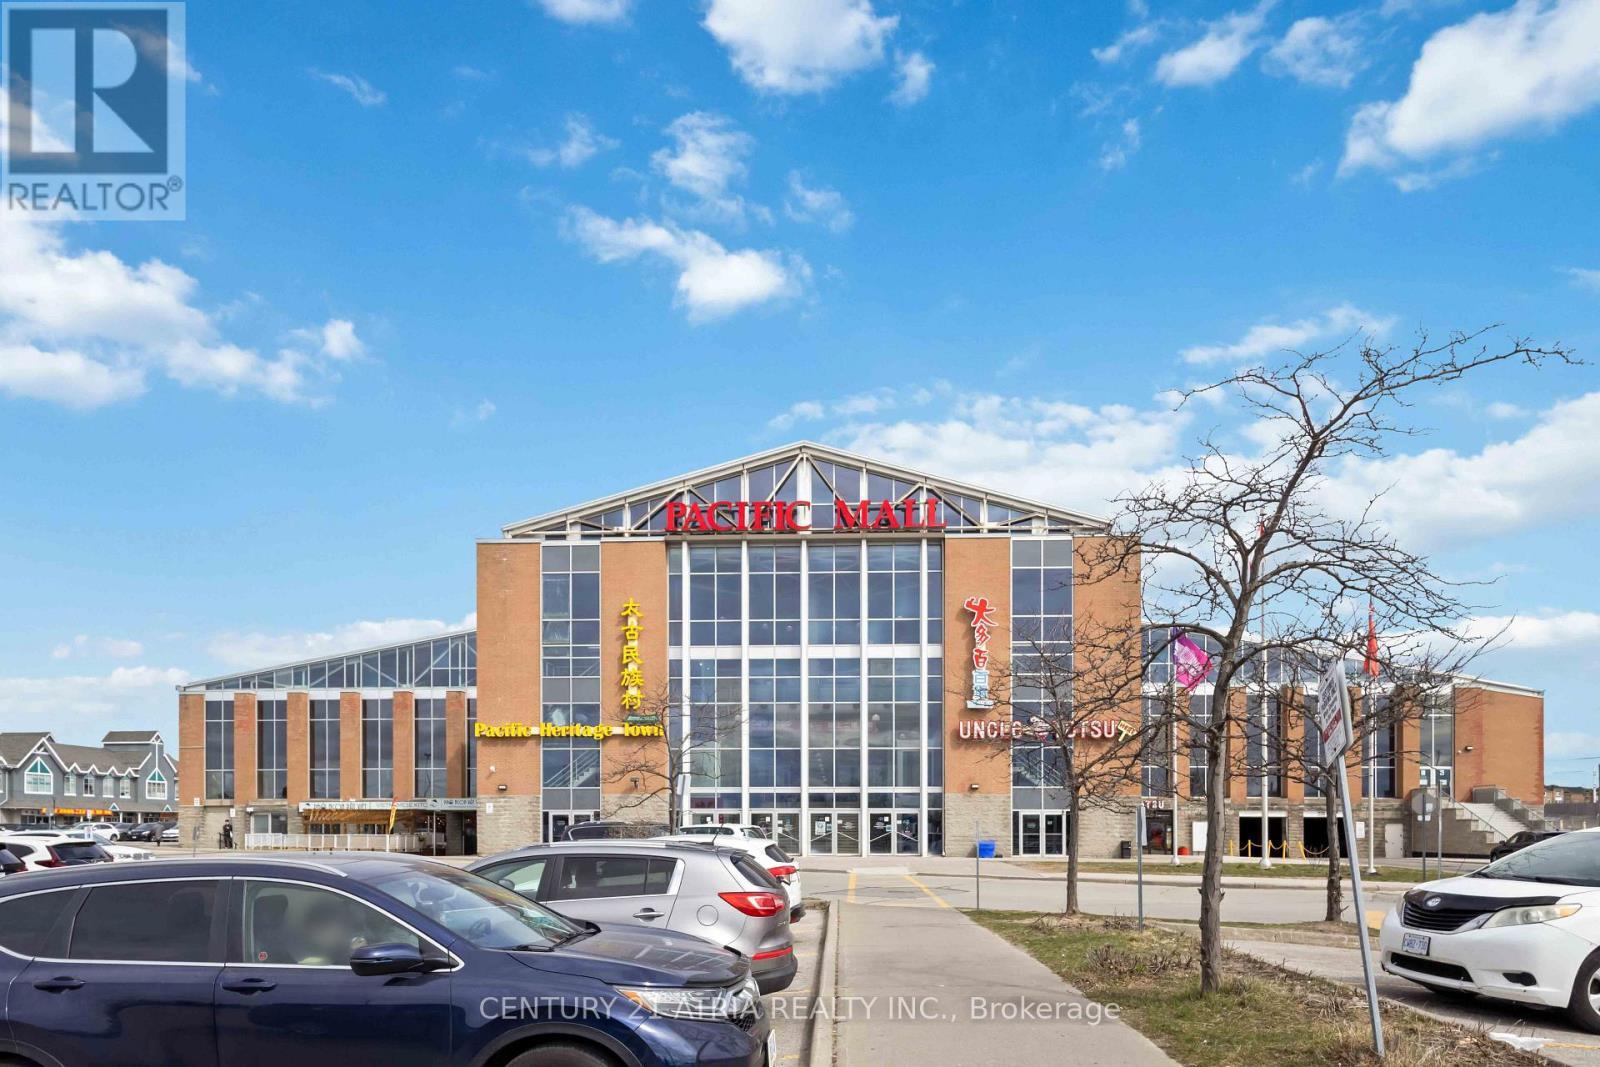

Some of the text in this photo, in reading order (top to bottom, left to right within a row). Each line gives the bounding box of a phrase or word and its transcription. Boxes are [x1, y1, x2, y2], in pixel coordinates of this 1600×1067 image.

[664, 498, 947, 531] PACIFIC MALL
[620, 597, 645, 710] 太古民族村
[474, 722, 532, 737] Pacific
[540, 722, 613, 740] Heritage
